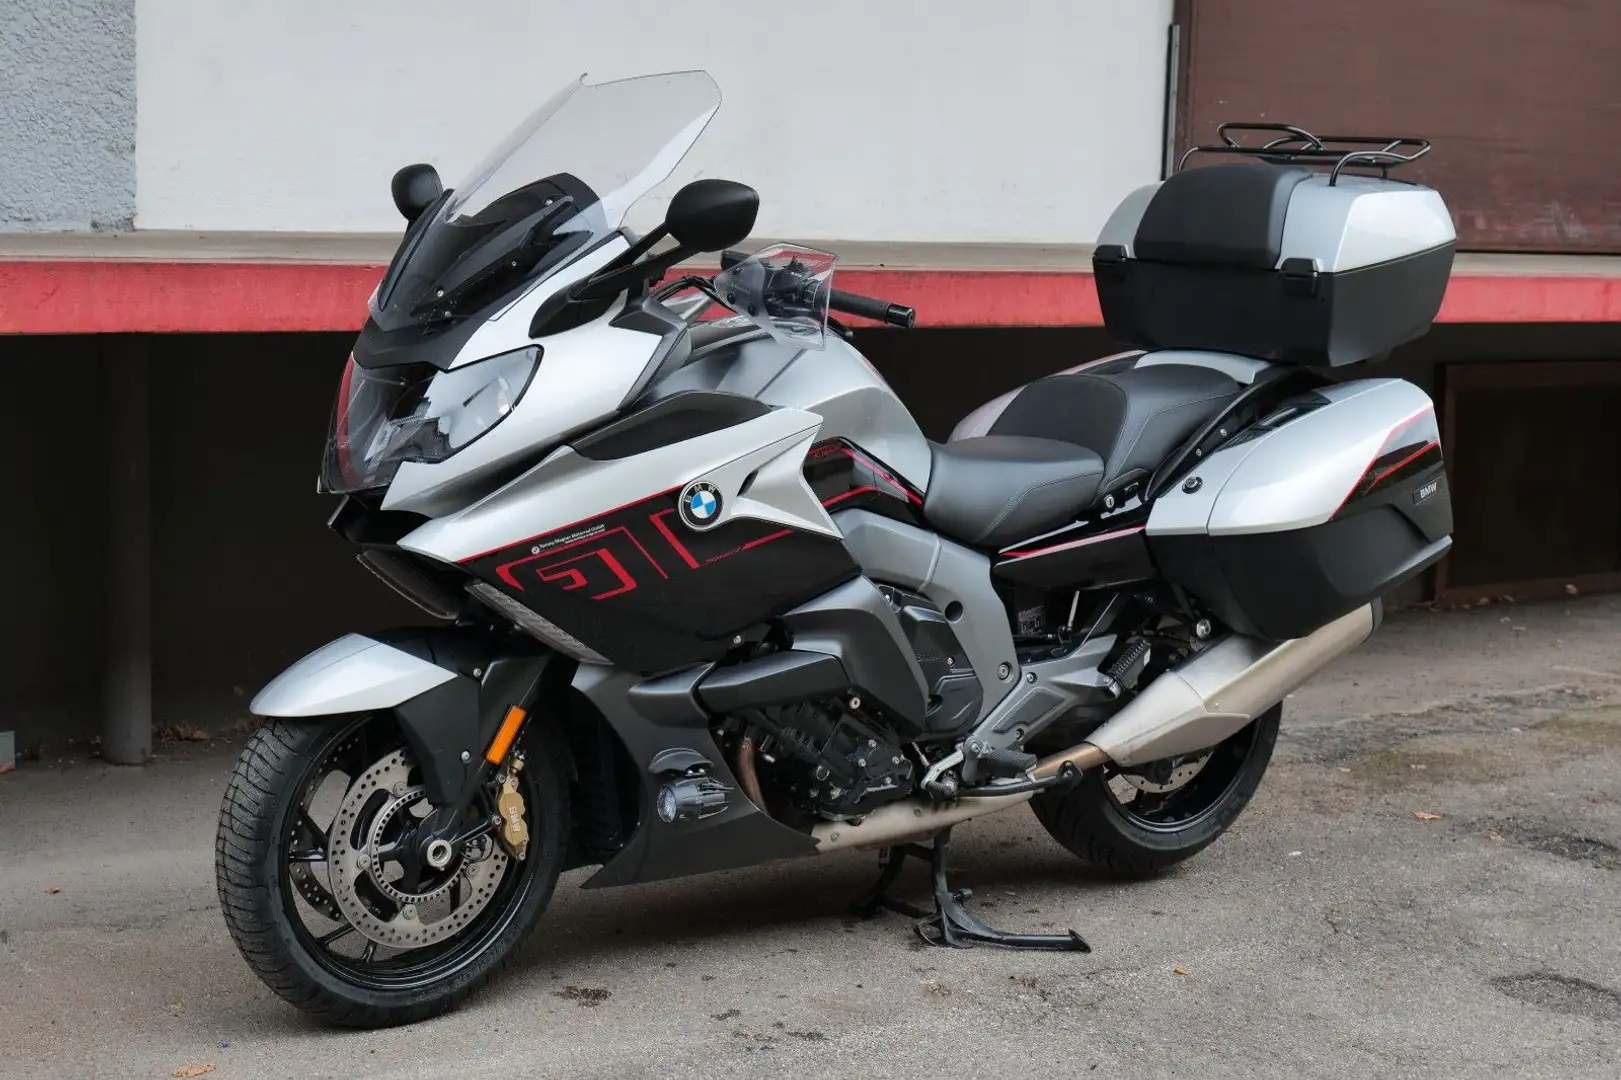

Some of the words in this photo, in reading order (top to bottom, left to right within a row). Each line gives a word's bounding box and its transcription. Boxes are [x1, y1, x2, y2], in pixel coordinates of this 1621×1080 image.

[684, 483, 716, 503] BMW
[1420, 481, 1437, 499] BMW
[571, 528, 591, 539] Motorrad
[509, 806, 521, 832] BMW
